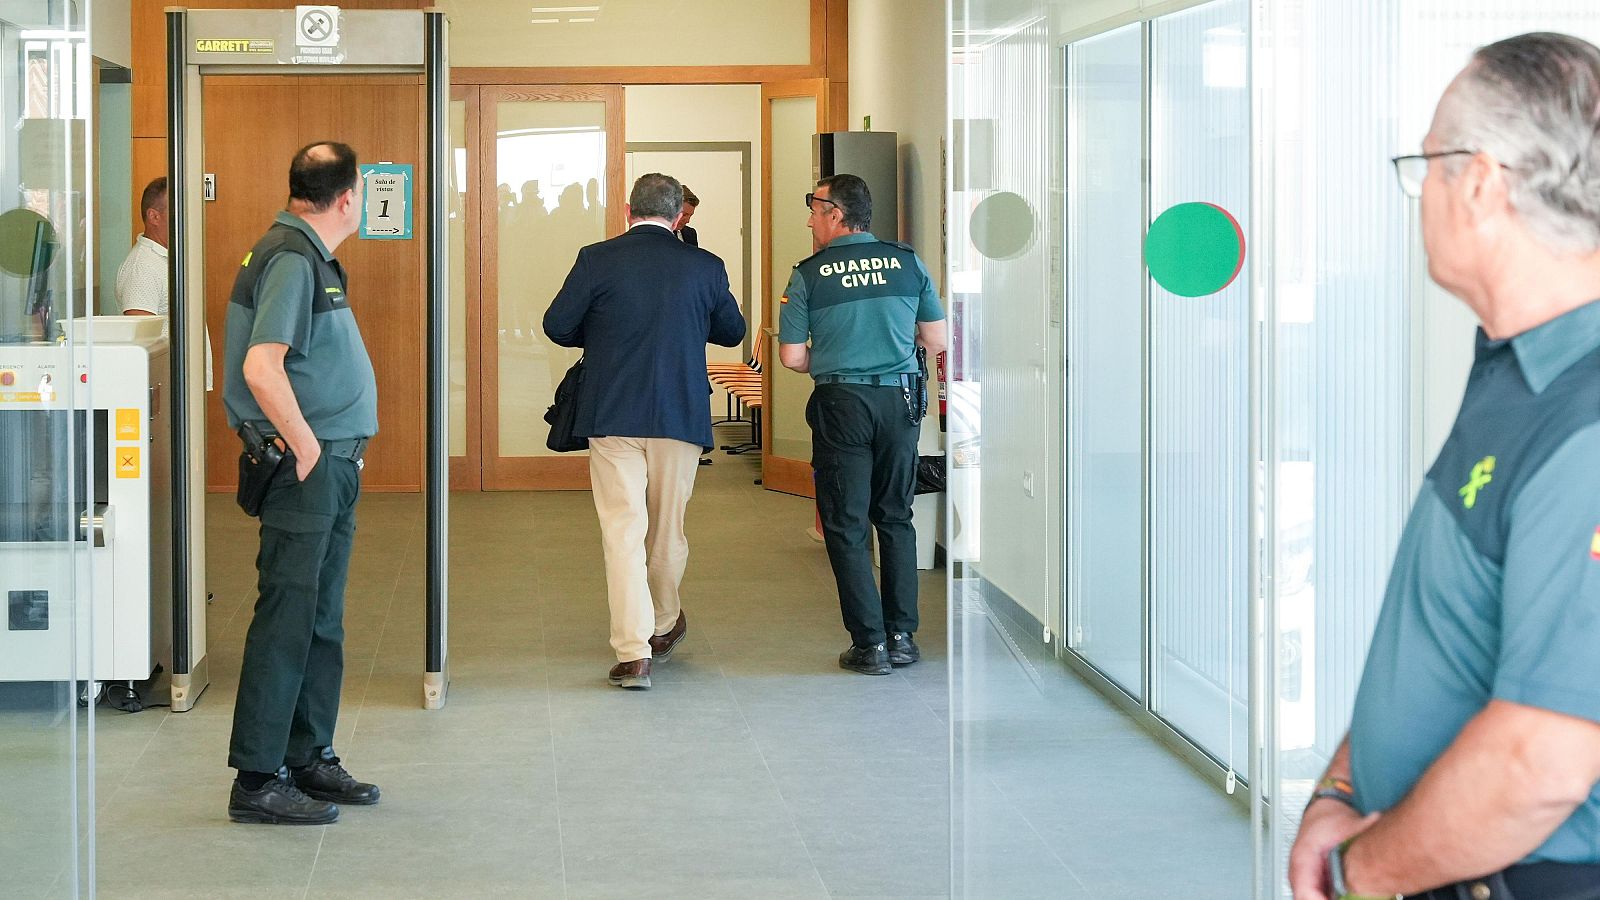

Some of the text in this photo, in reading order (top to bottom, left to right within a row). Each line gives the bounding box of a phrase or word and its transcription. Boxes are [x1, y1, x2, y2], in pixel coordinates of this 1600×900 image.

[197, 40, 249, 52] GARRETT
[378, 199, 390, 218] 1
[819, 257, 902, 277] GUARDIA
[841, 271, 887, 288] CIVIL
